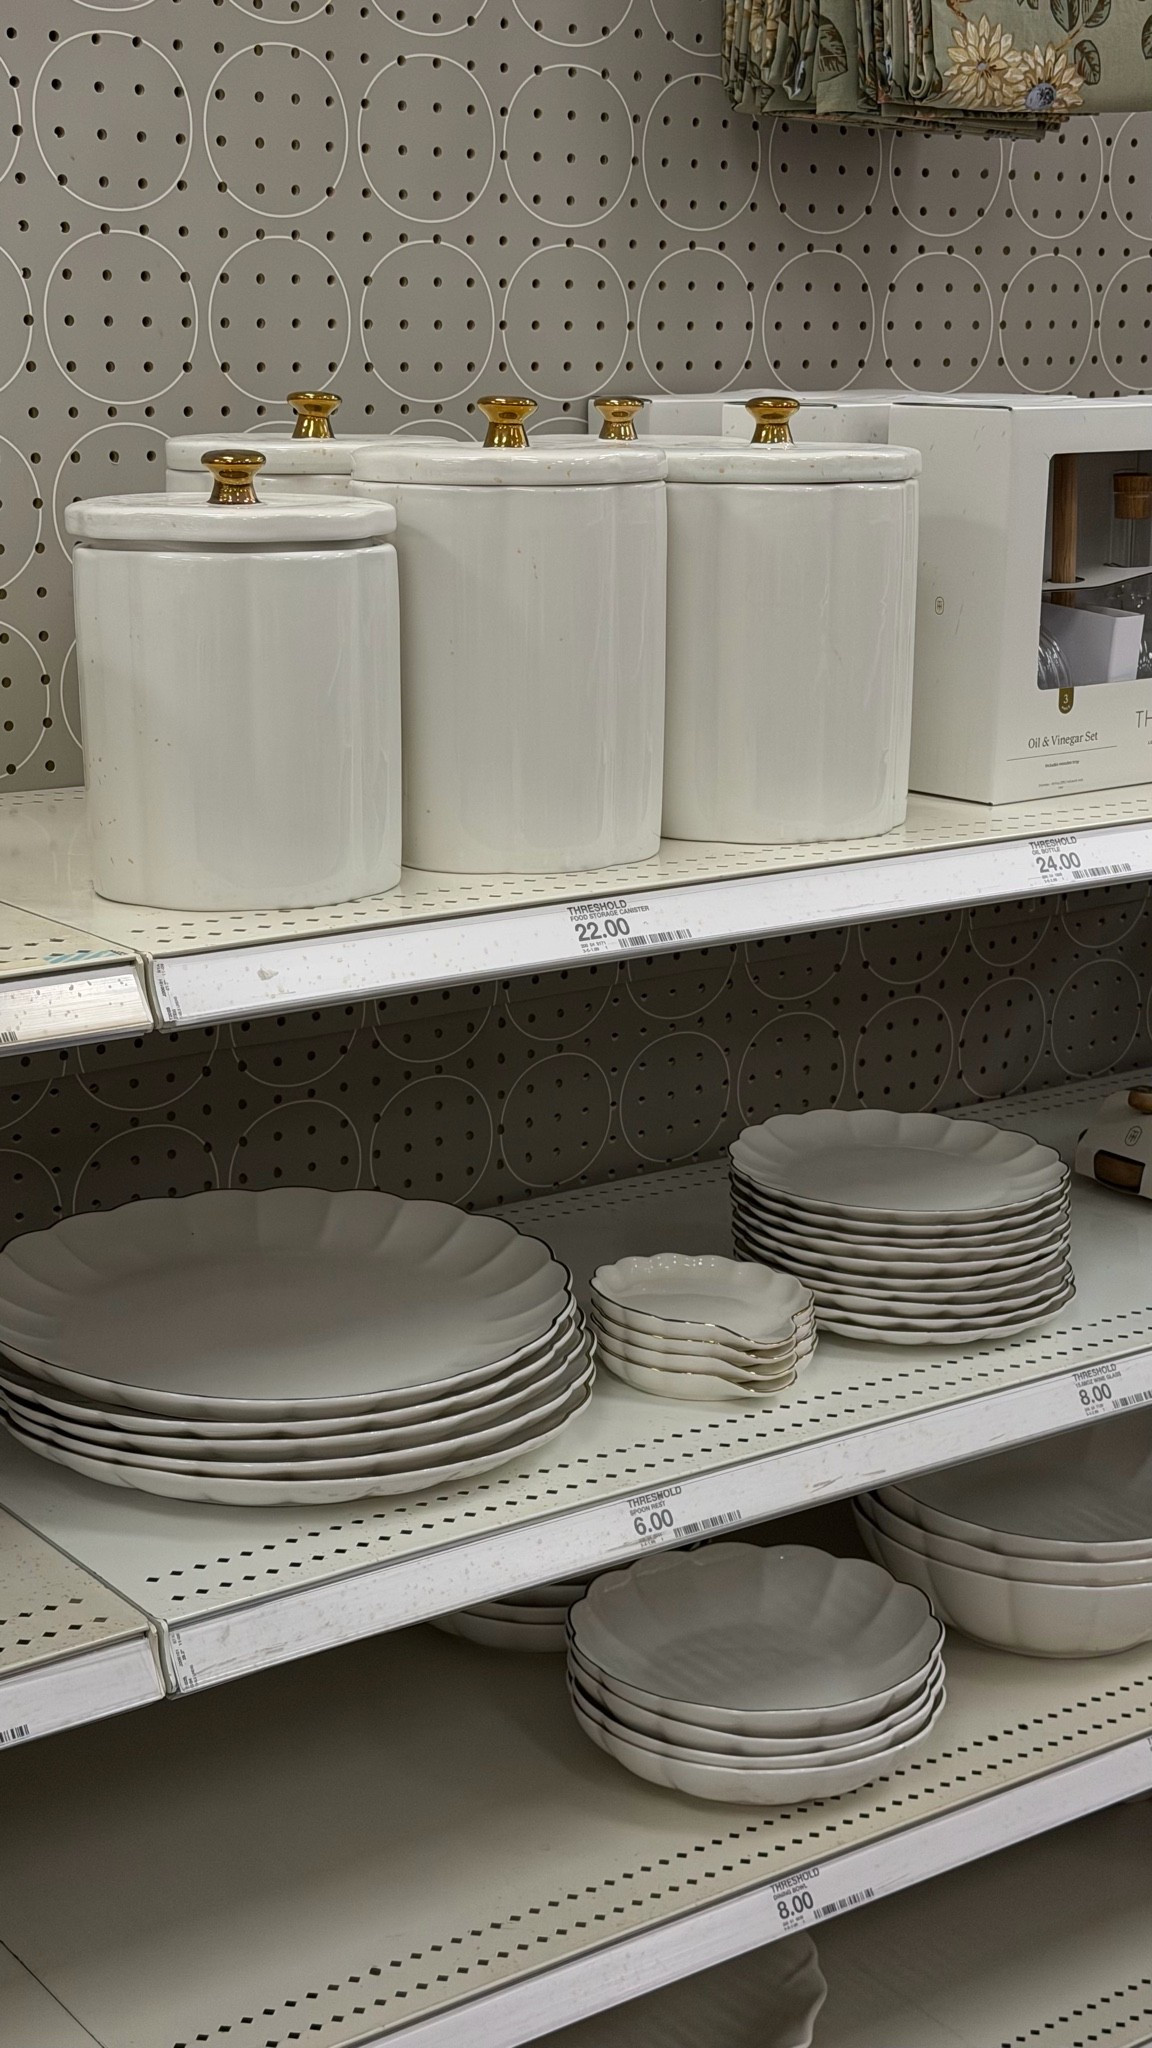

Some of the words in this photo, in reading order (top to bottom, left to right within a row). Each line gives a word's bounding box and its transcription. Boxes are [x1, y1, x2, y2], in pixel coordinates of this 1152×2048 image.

[1063, 694, 1069, 704] 3
[1028, 738, 1040, 749] Oil
[1042, 736, 1050, 747] &
[1051, 734, 1084, 746] Vinegar
[1085, 730, 1098, 742] Set
[1028, 836, 1077, 850] THRESHOLD
[1041, 847, 1061, 855] BOTTLE
[1036, 852, 1081, 873] 24.00
[566, 900, 627, 916] THRESHOLD
[570, 913, 588, 922] FOOD
[588, 909, 619, 919] STORAGE
[619, 905, 650, 915] CANISTER
[574, 917, 630, 942] 22.00
[1072, 1363, 1117, 1382] THRESHOLD
[1078, 1383, 1112, 1405] 8.00
[626, 1485, 682, 1508] THRESHOLD
[629, 1505, 651, 1517] SPOON
[651, 1501, 666, 1511] REST
[633, 1508, 674, 1536] 6.00
[770, 1867, 820, 1893] THRESHOLD
[773, 1889, 792, 1901] DINING
[792, 1884, 808, 1893] BOWL
[777, 1891, 814, 1920] 8.00
